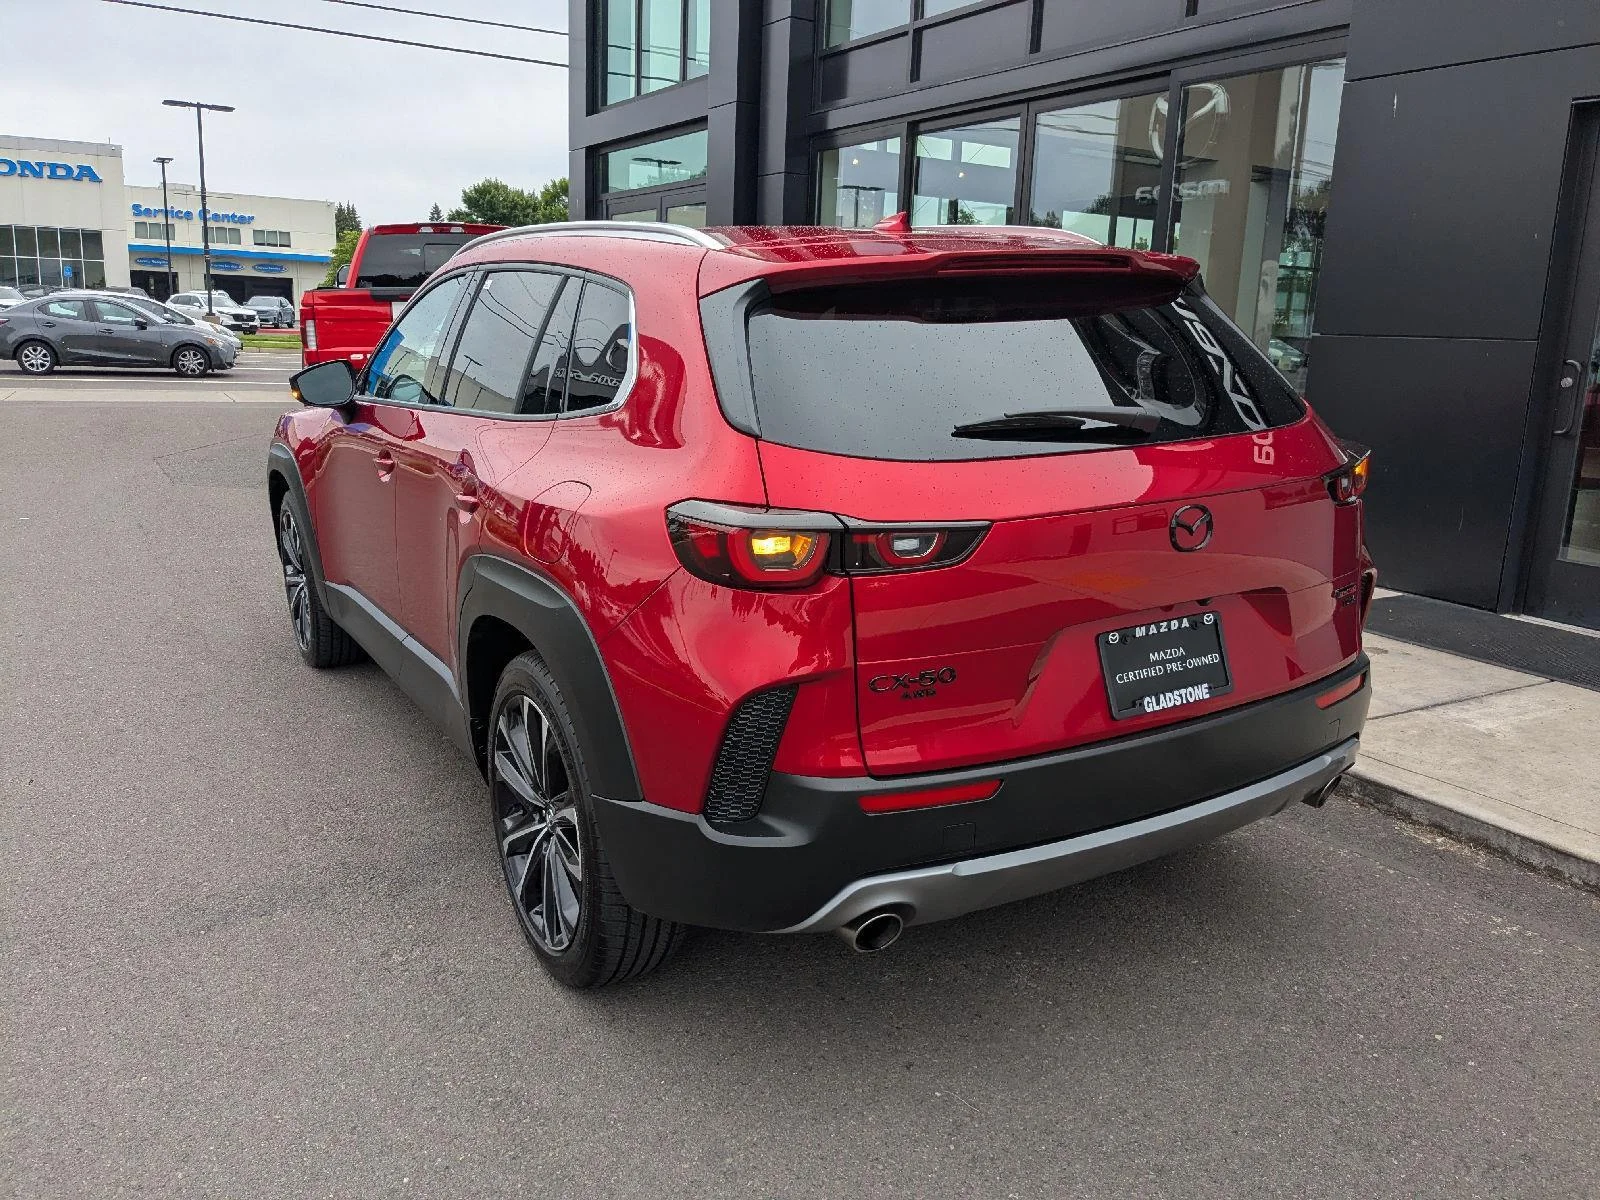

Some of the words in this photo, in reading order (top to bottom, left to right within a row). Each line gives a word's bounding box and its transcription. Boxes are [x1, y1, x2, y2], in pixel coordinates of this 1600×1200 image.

[131, 203, 194, 220] Service
[198, 208, 255, 224] Center
[1135, 617, 1190, 638] MAZDA
[1149, 646, 1186, 663] MAZDA
[868, 666, 957, 693] CX-50
[1115, 665, 1164, 684] CERTIFIED
[1166, 653, 1220, 674] PRE-OWNED
[1143, 682, 1210, 713] GLADSTONE
